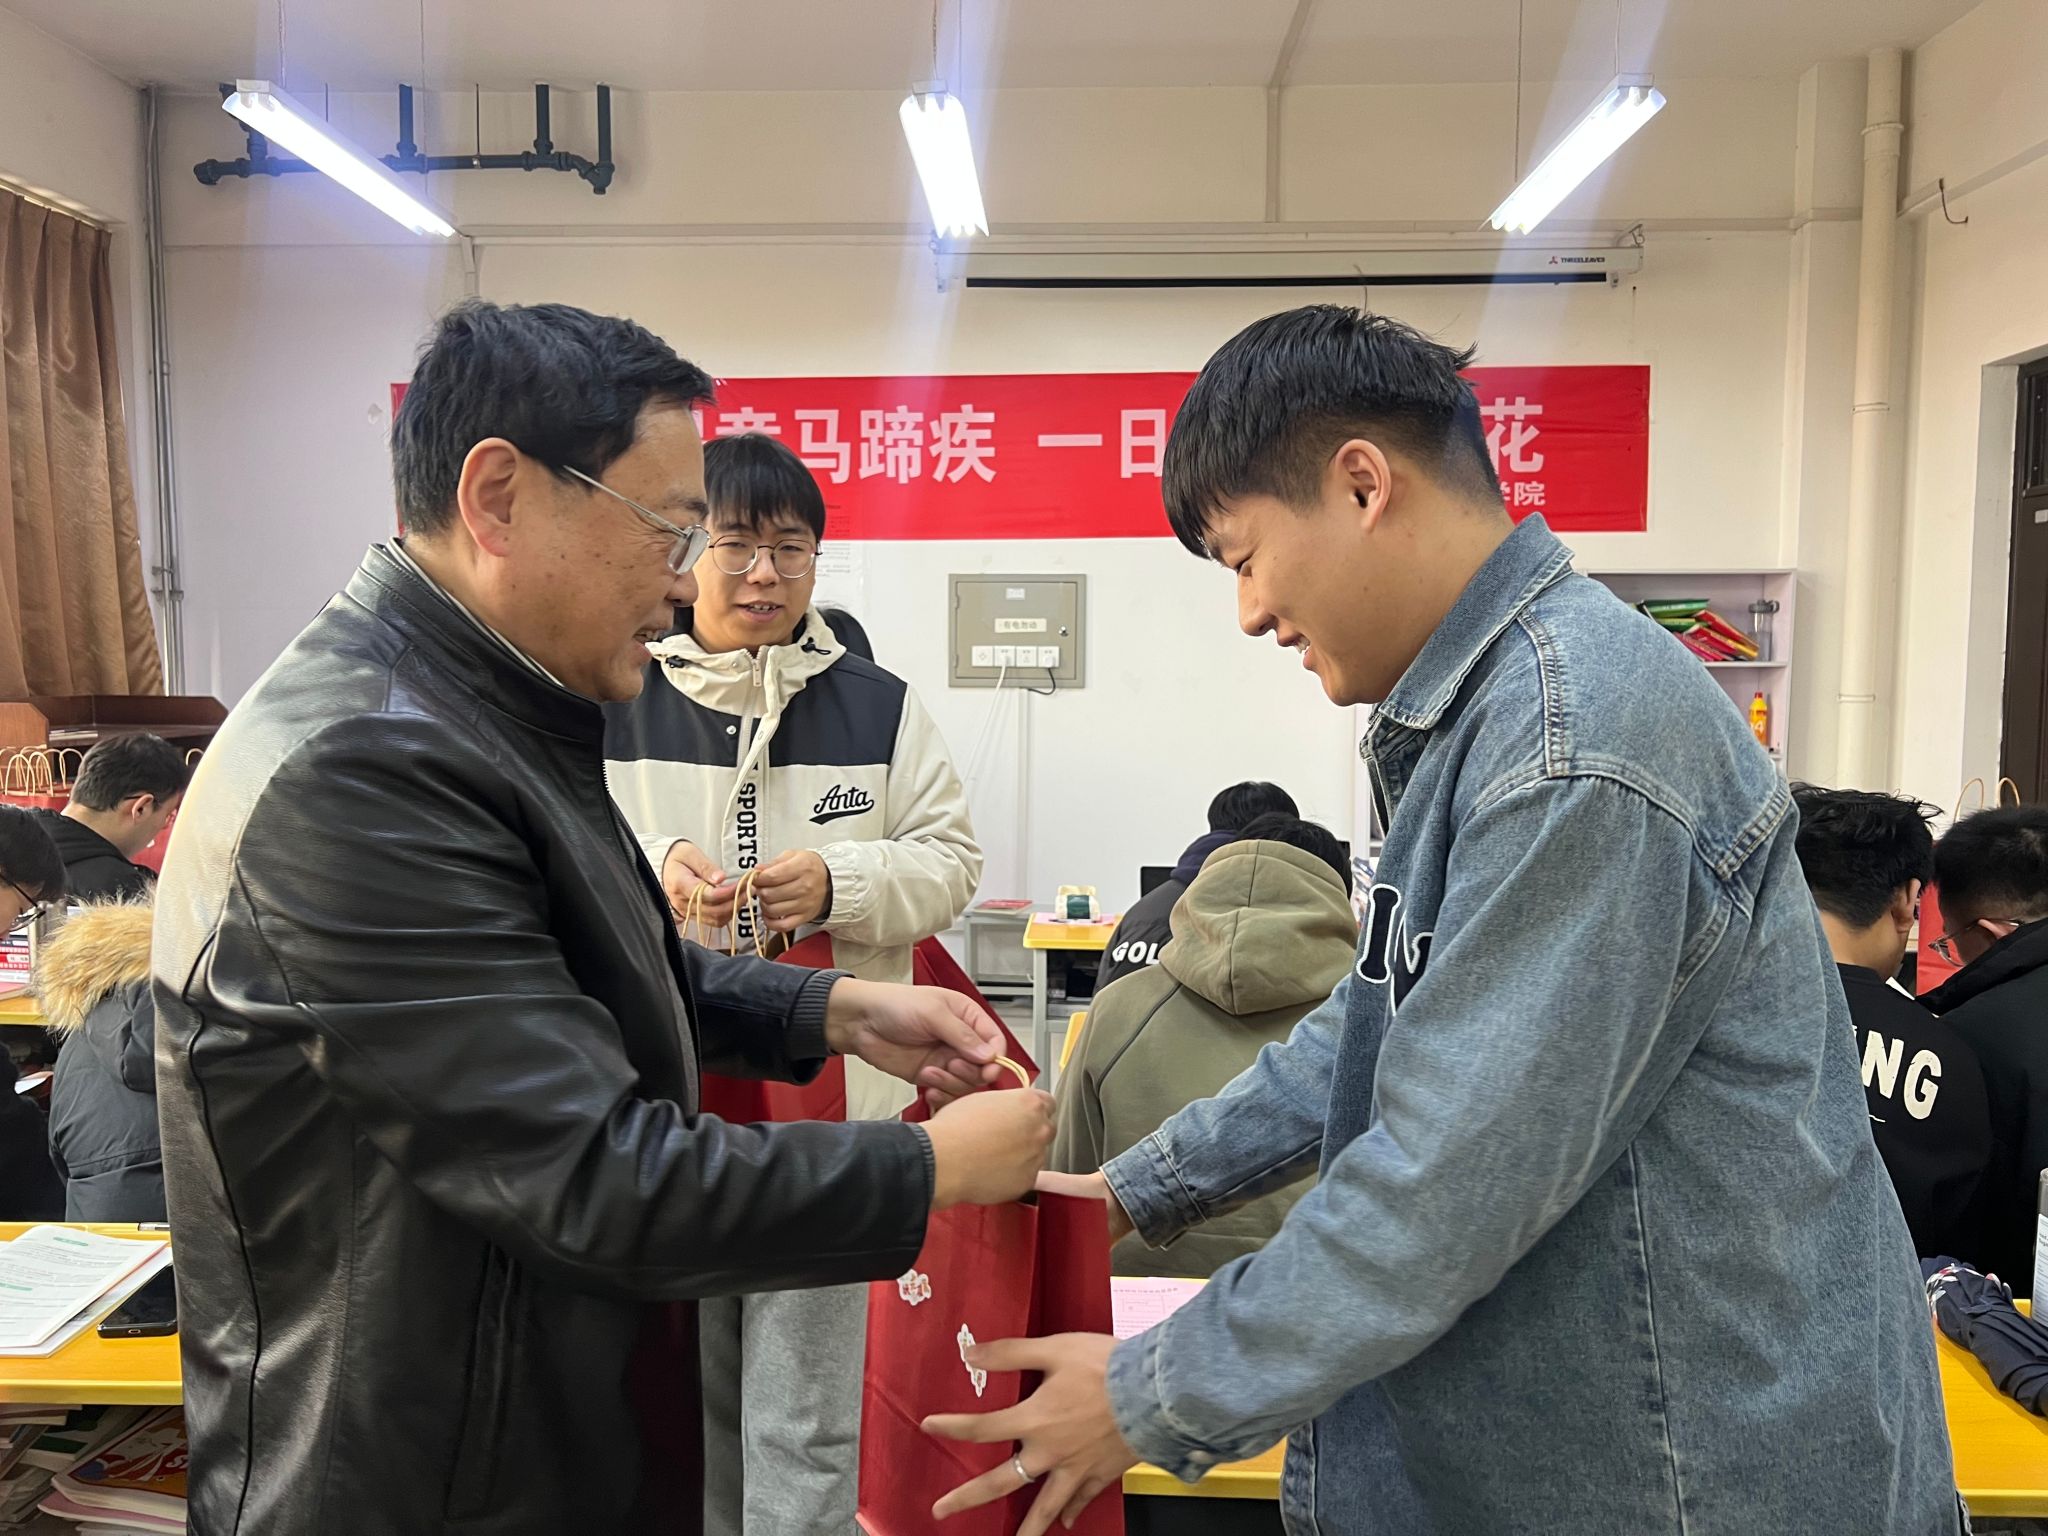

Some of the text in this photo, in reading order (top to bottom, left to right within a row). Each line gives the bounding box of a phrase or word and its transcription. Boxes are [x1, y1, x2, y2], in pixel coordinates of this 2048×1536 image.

[692, 403, 997, 484] 马蹄疾
[1480, 397, 1544, 473] 花
[736, 782, 758, 869] SPORTS
[813, 784, 875, 814] Anta
[1852, 1024, 1942, 1120] NG
